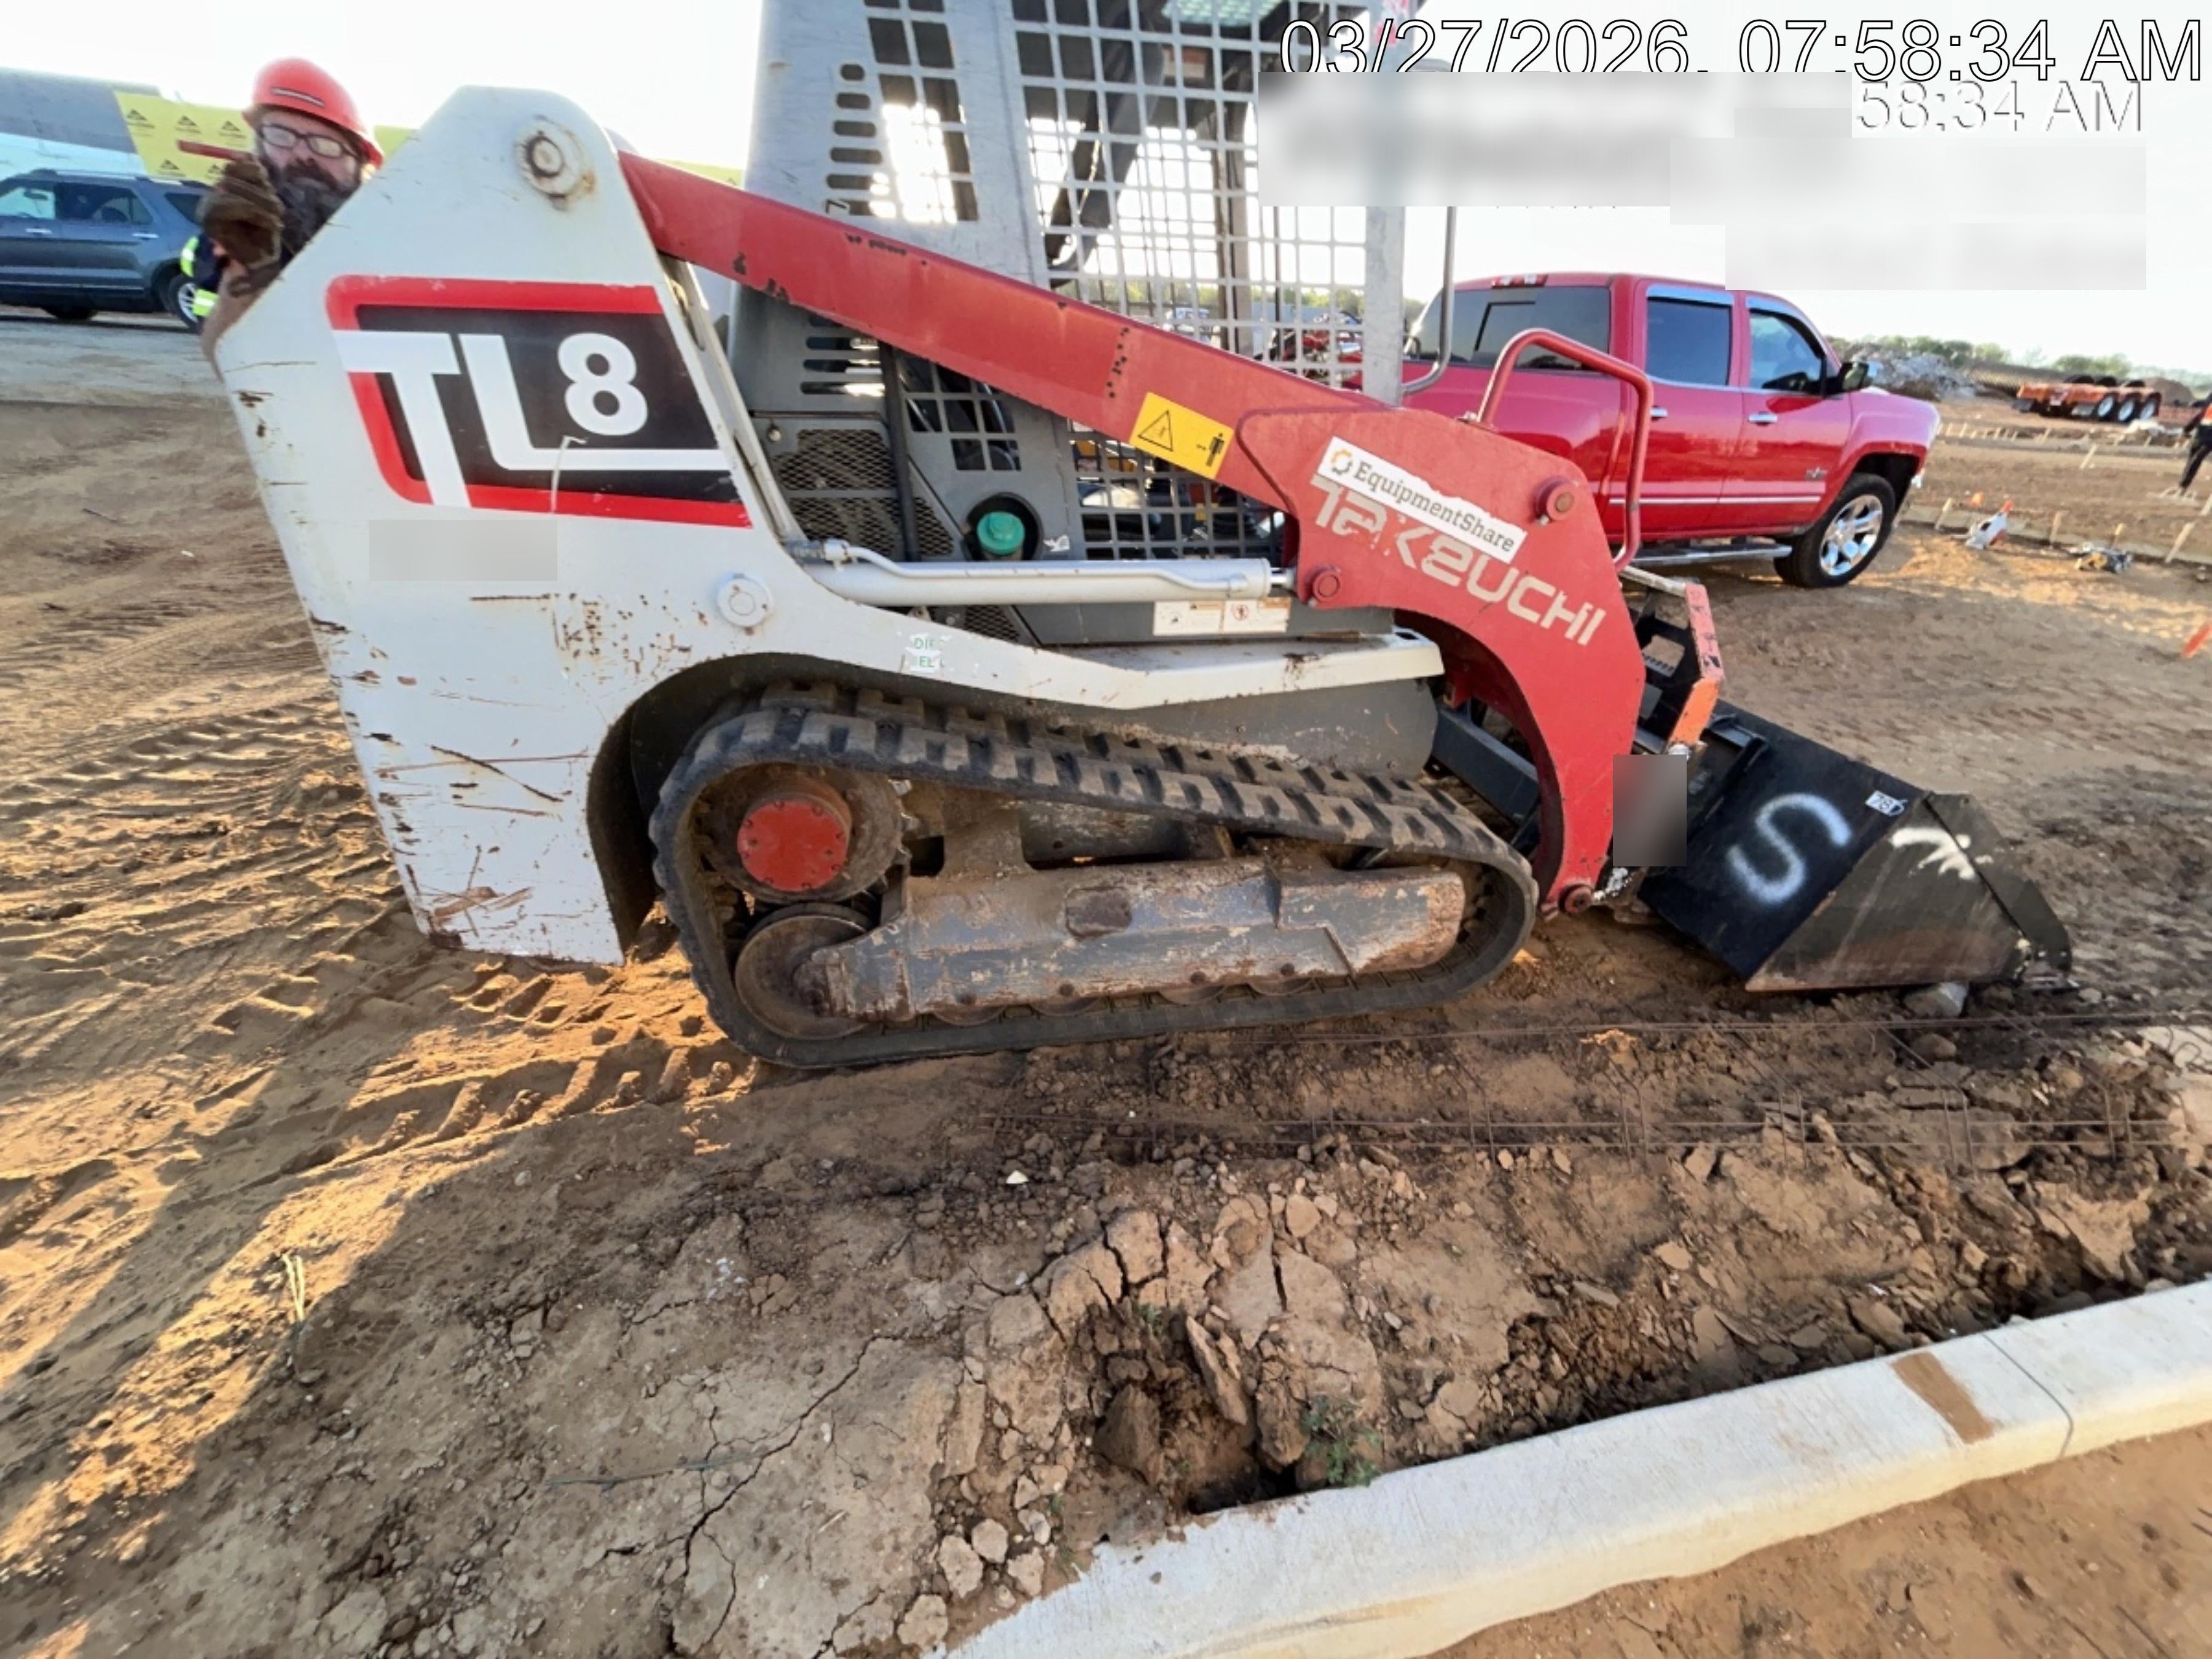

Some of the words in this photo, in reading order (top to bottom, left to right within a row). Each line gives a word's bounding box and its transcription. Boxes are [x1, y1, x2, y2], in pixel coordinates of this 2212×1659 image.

[332, 331, 732, 509] TL8
[1353, 460, 1516, 552] EquipmentShare
[1725, 793, 1852, 904] S
